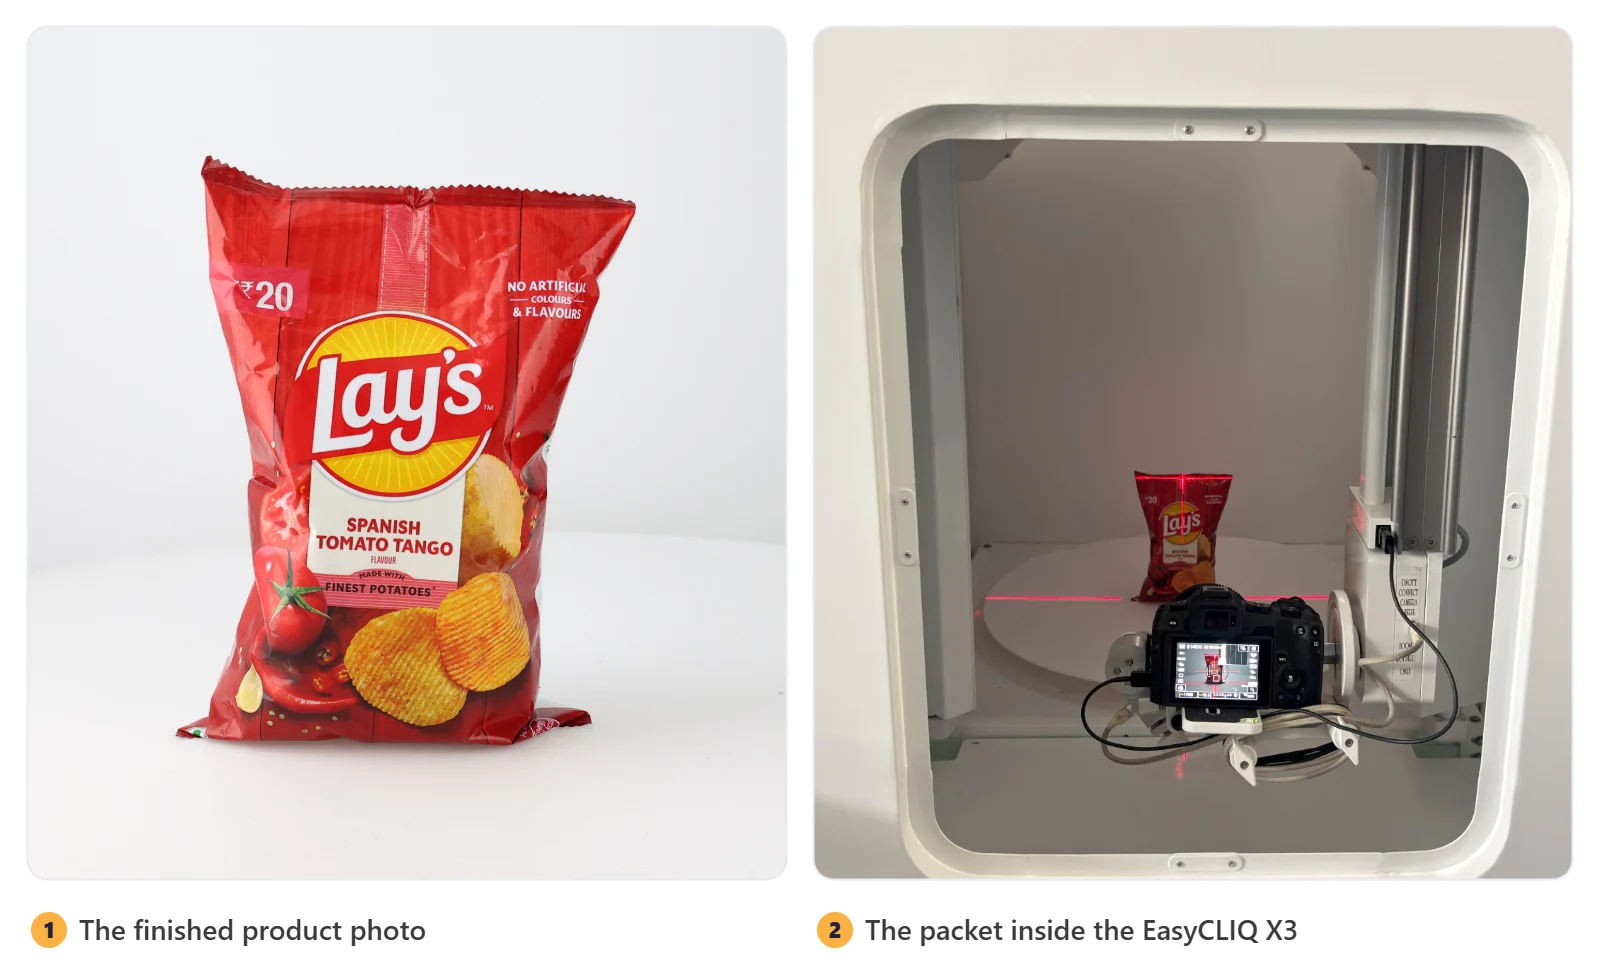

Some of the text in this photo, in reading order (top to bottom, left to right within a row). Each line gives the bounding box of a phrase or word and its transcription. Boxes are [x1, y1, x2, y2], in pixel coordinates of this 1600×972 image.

[507, 281, 526, 292] NO
[531, 295, 572, 305] COLOURS
[513, 306, 582, 319] & FLAVOURS
[312, 349, 483, 453] Lay's
[347, 517, 421, 535] SPANISH
[316, 535, 454, 556] TOMATO TANGO
[370, 555, 397, 564] FLAVOUR
[358, 570, 405, 580] MADE WITH
[325, 582, 366, 593] FINEST
